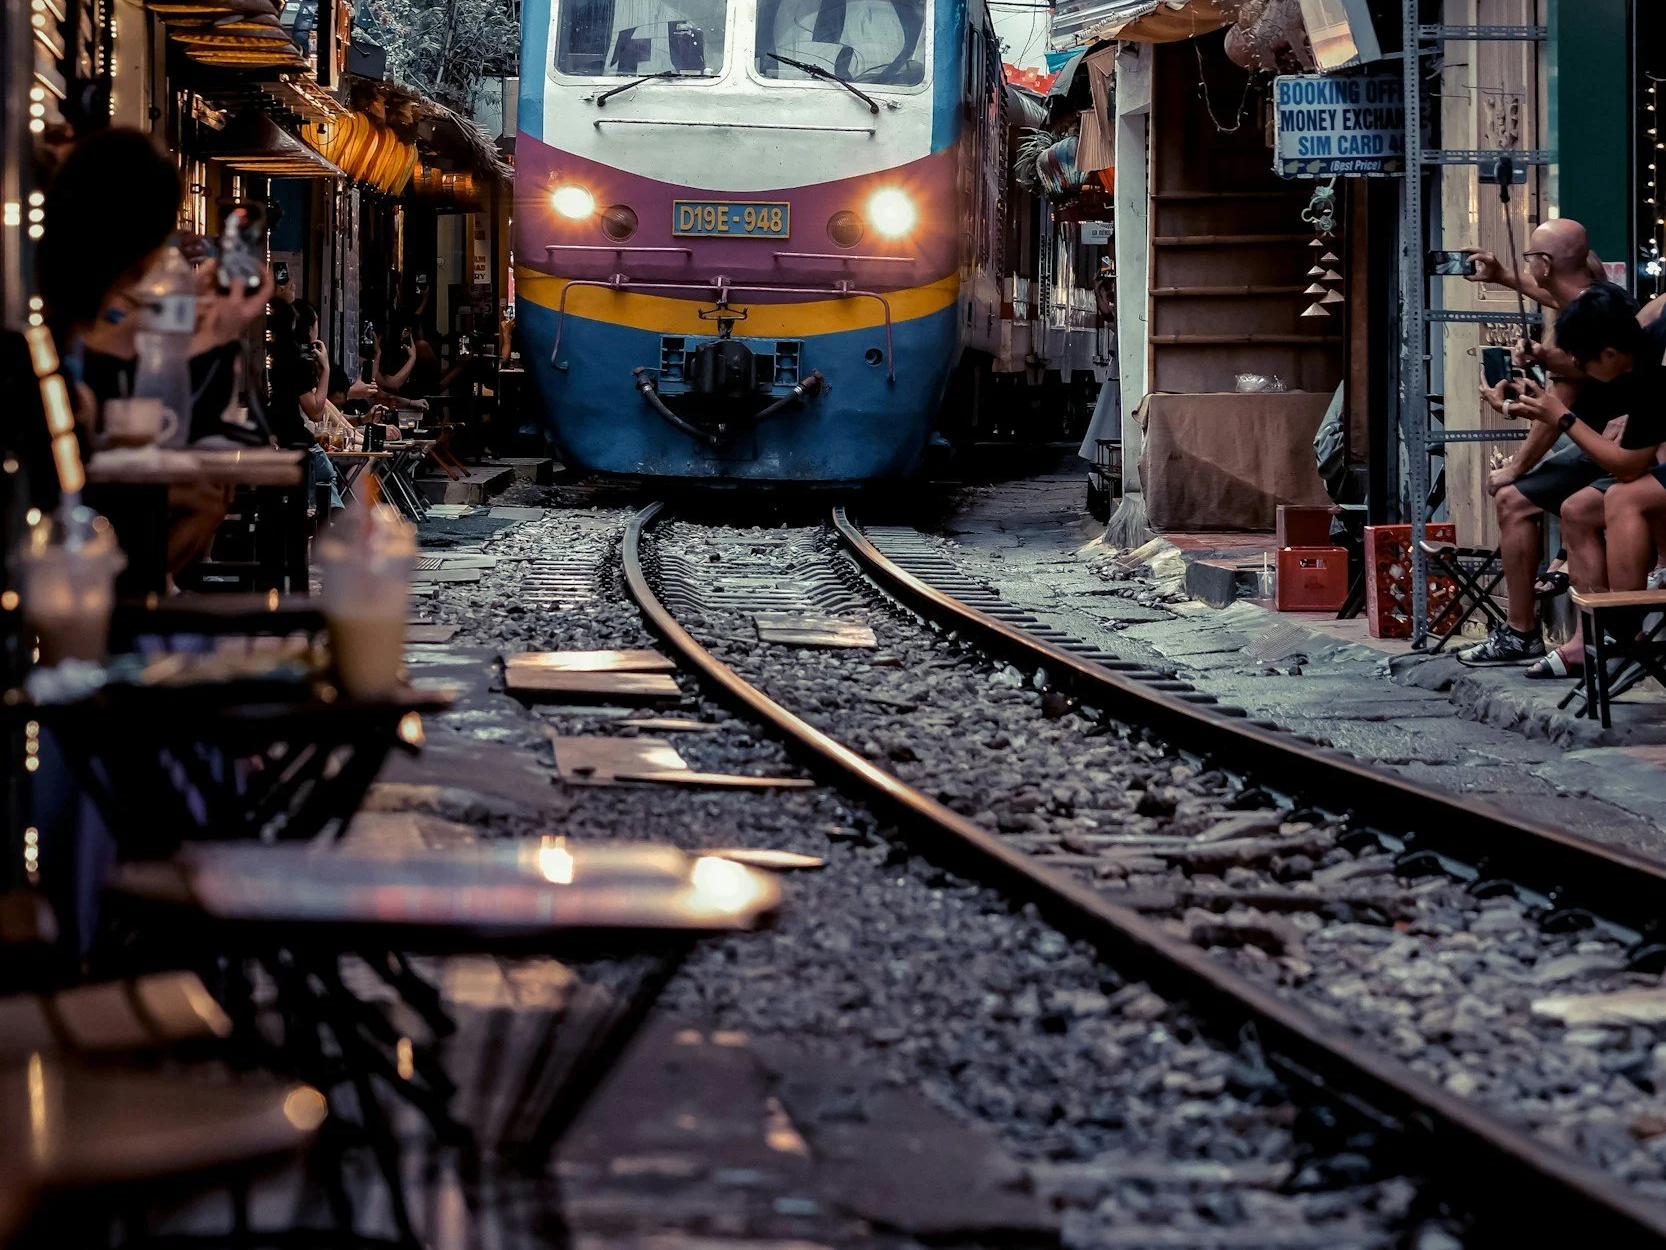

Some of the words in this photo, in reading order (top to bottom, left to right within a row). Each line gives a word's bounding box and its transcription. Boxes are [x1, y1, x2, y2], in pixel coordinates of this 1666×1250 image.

[1279, 80, 1361, 106] BOOKING
[1280, 109, 1337, 132] MONEY
[1298, 135, 1332, 156] SIM
[1337, 134, 1384, 155] CARD
[1330, 159, 1353, 172] (Best
[1354, 159, 1382, 171] Price)
